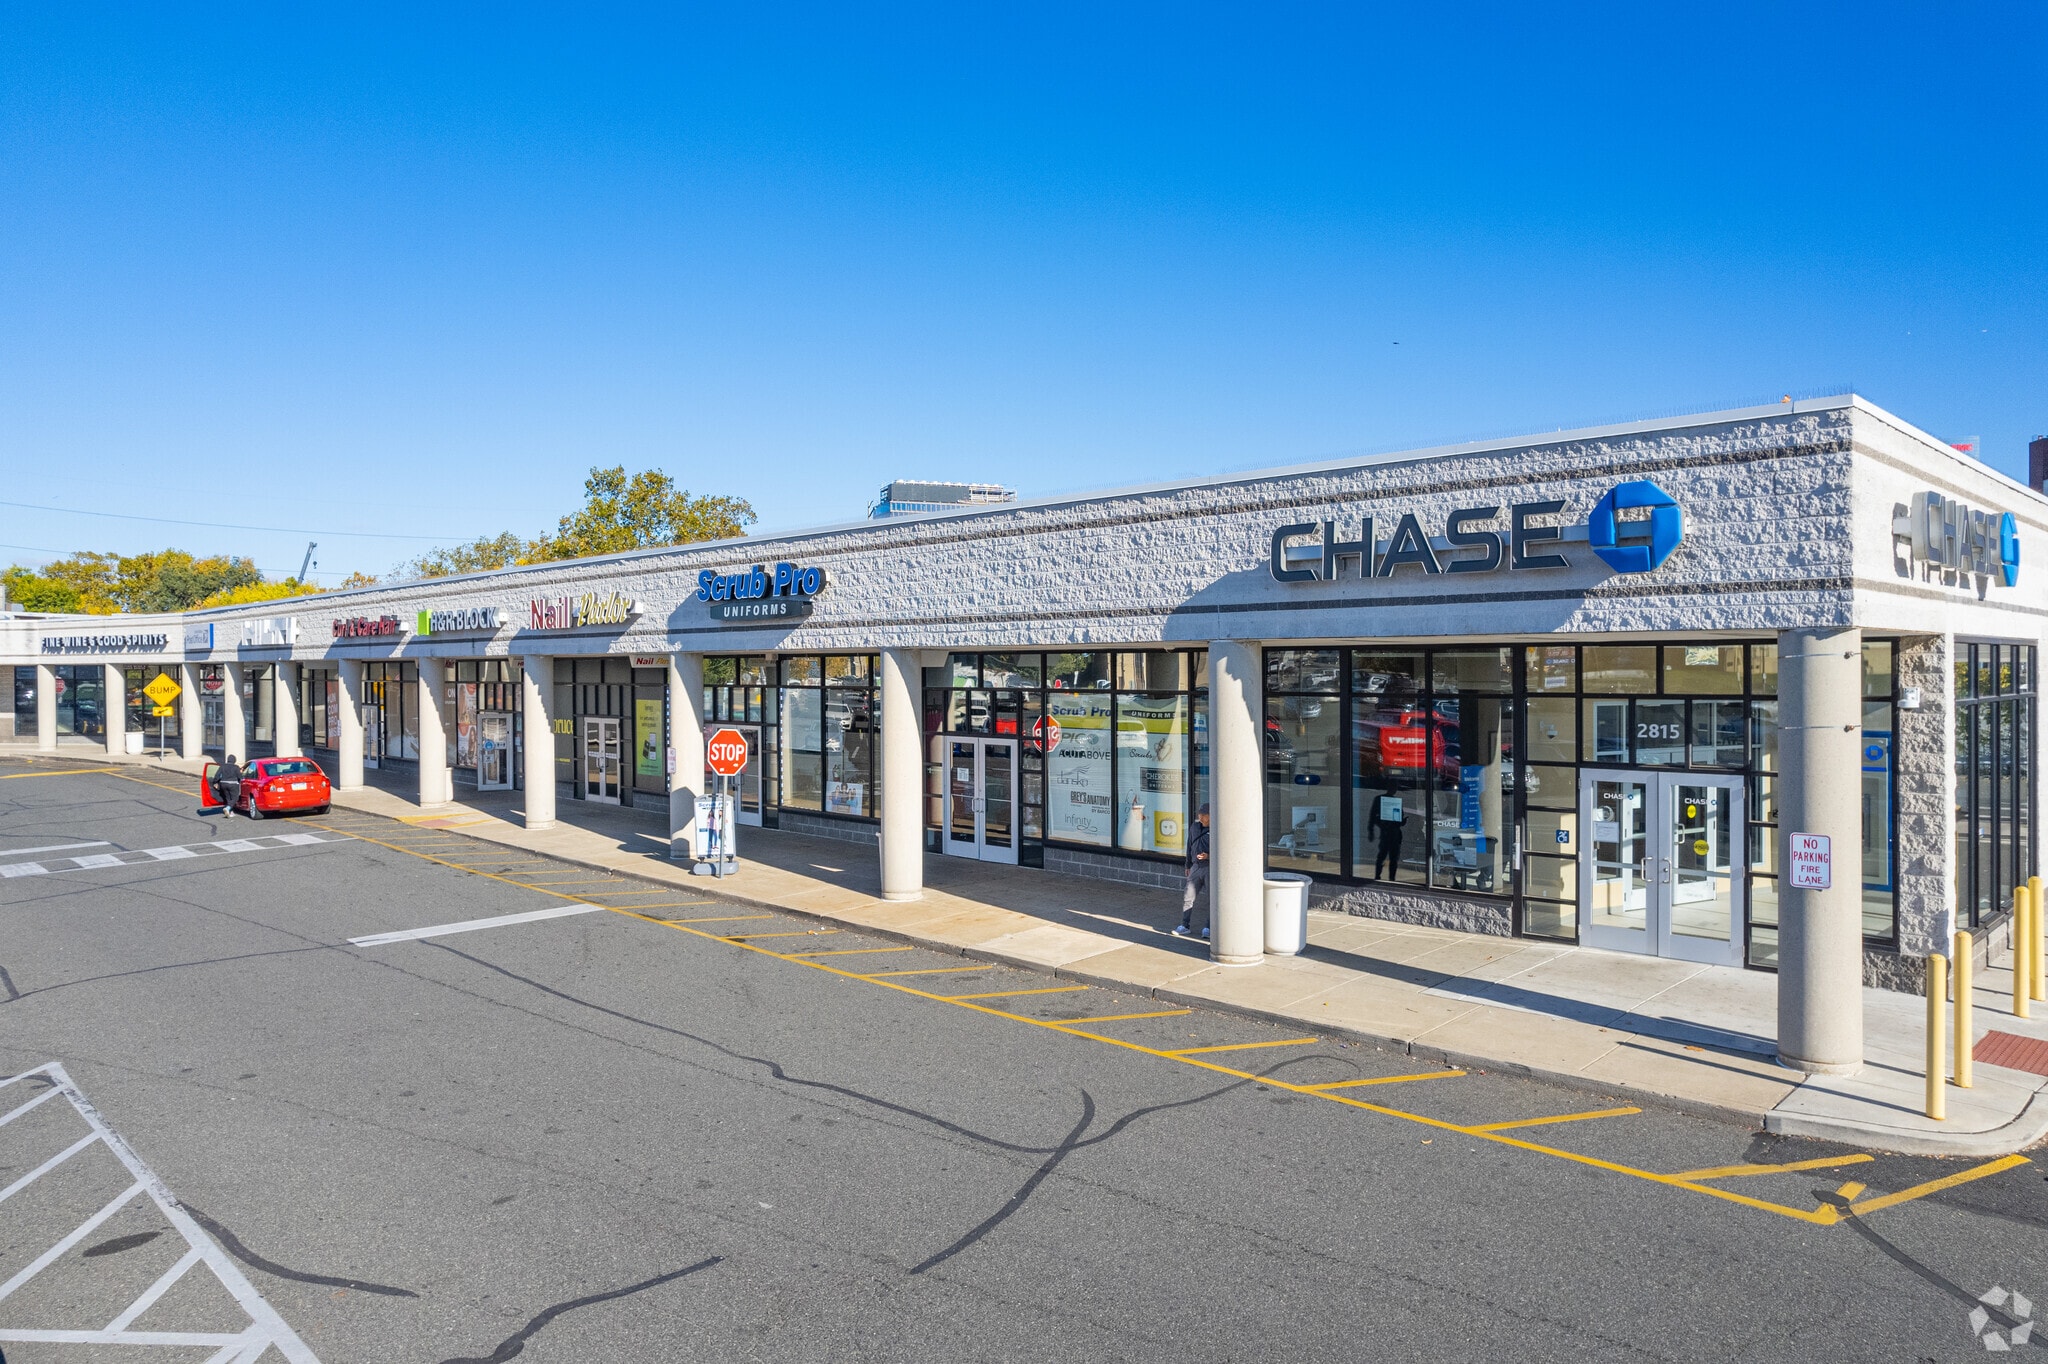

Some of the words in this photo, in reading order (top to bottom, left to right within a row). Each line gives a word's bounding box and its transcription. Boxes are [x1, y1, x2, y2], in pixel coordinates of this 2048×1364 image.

[1912, 490, 1999, 577] CHASE
[1270, 500, 1572, 583] CHASE
[696, 565, 766, 602] Scrub
[773, 562, 821, 597] Pro
[530, 596, 570, 630] Nail
[577, 592, 632, 627] Parlor
[723, 603, 787, 617] UNIFORMS
[349, 617, 355, 637] &
[357, 616, 377, 637] Care
[378, 614, 397, 635] Hair
[430, 610, 455, 632] H&R
[456, 606, 497, 630] BLOCK
[41, 637, 61, 648] FINE
[63, 636, 87, 647] WINE
[98, 635, 123, 647] GOOD
[126, 633, 165, 646] SPIRITS
[150, 686, 175, 694] BUMP
[1052, 705, 1086, 716] Scrub
[1091, 707, 1112, 717] Pro
[1636, 723, 1680, 739] 2815
[711, 743, 745, 761] STOP
[1803, 839, 1818, 849] NO
[1793, 851, 1829, 864] PARKING
[1801, 864, 1820, 874] FIRE
[1798, 875, 1823, 884] LANE
